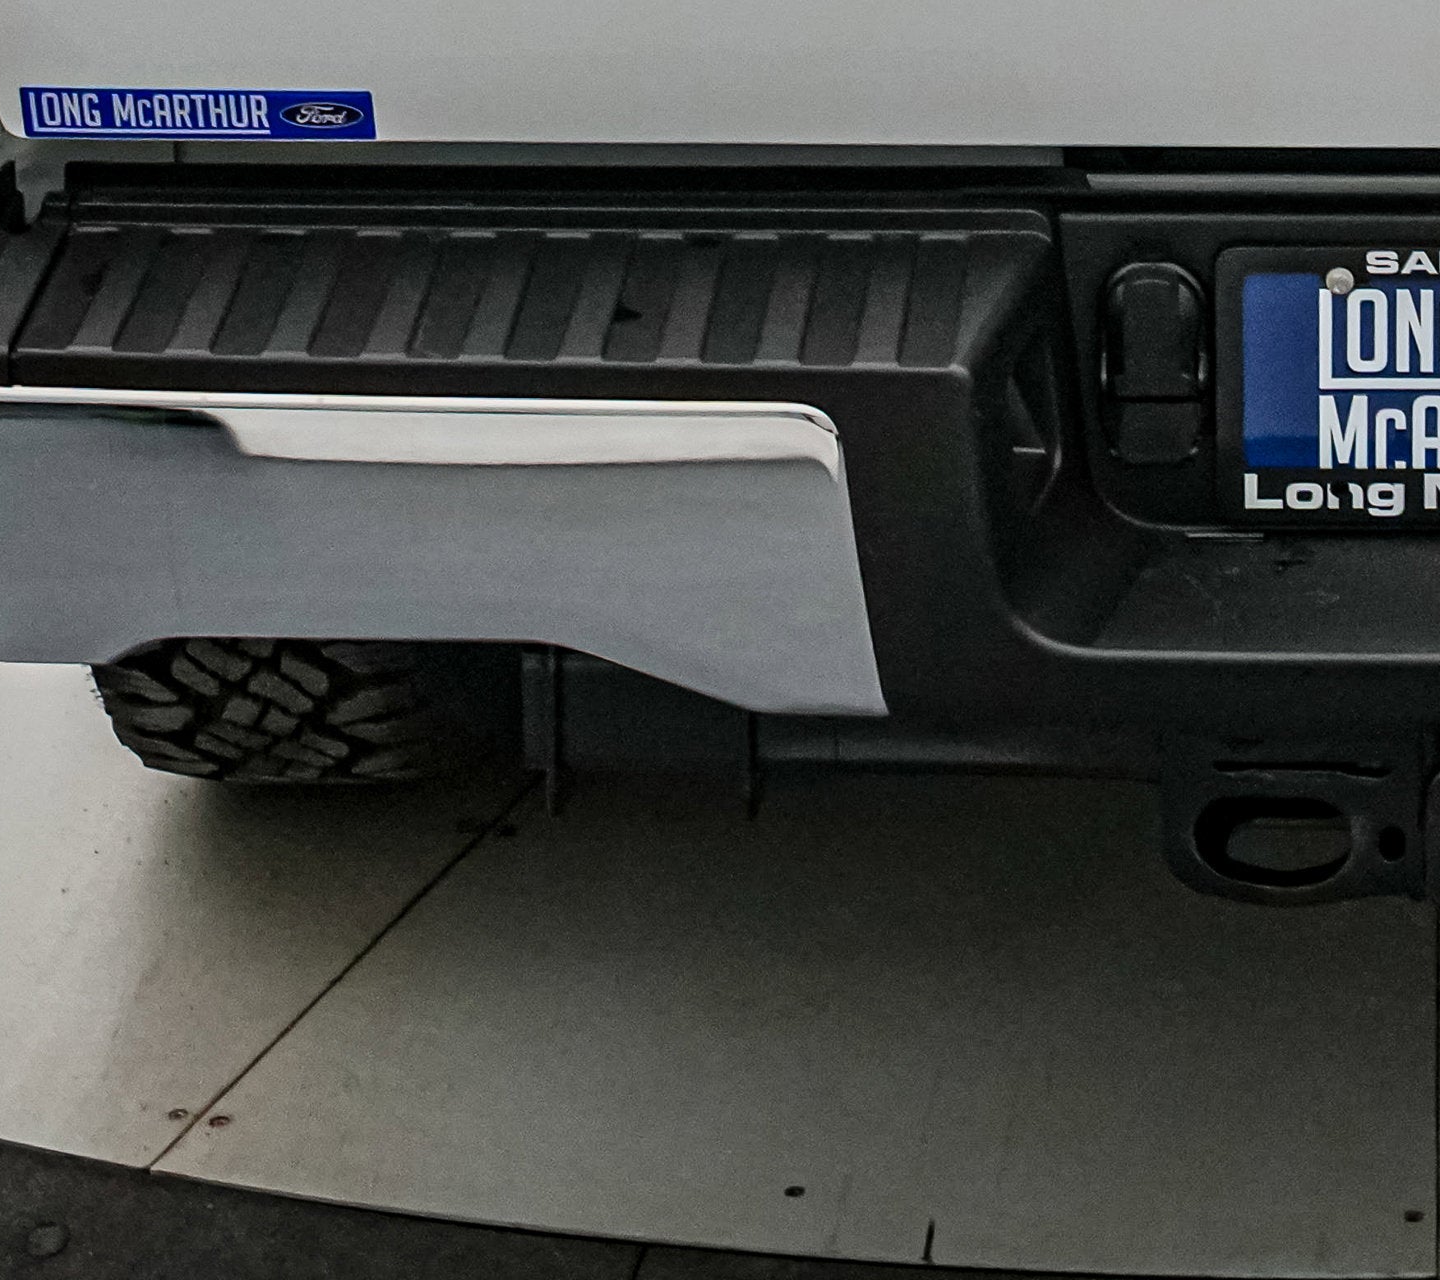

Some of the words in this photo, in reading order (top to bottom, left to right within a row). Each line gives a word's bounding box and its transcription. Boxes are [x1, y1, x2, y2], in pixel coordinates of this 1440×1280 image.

[28, 91, 102, 130] LONG
[113, 93, 271, 129] McARTHUR
[294, 104, 348, 126] Ford
[1243, 473, 1406, 517] Long
